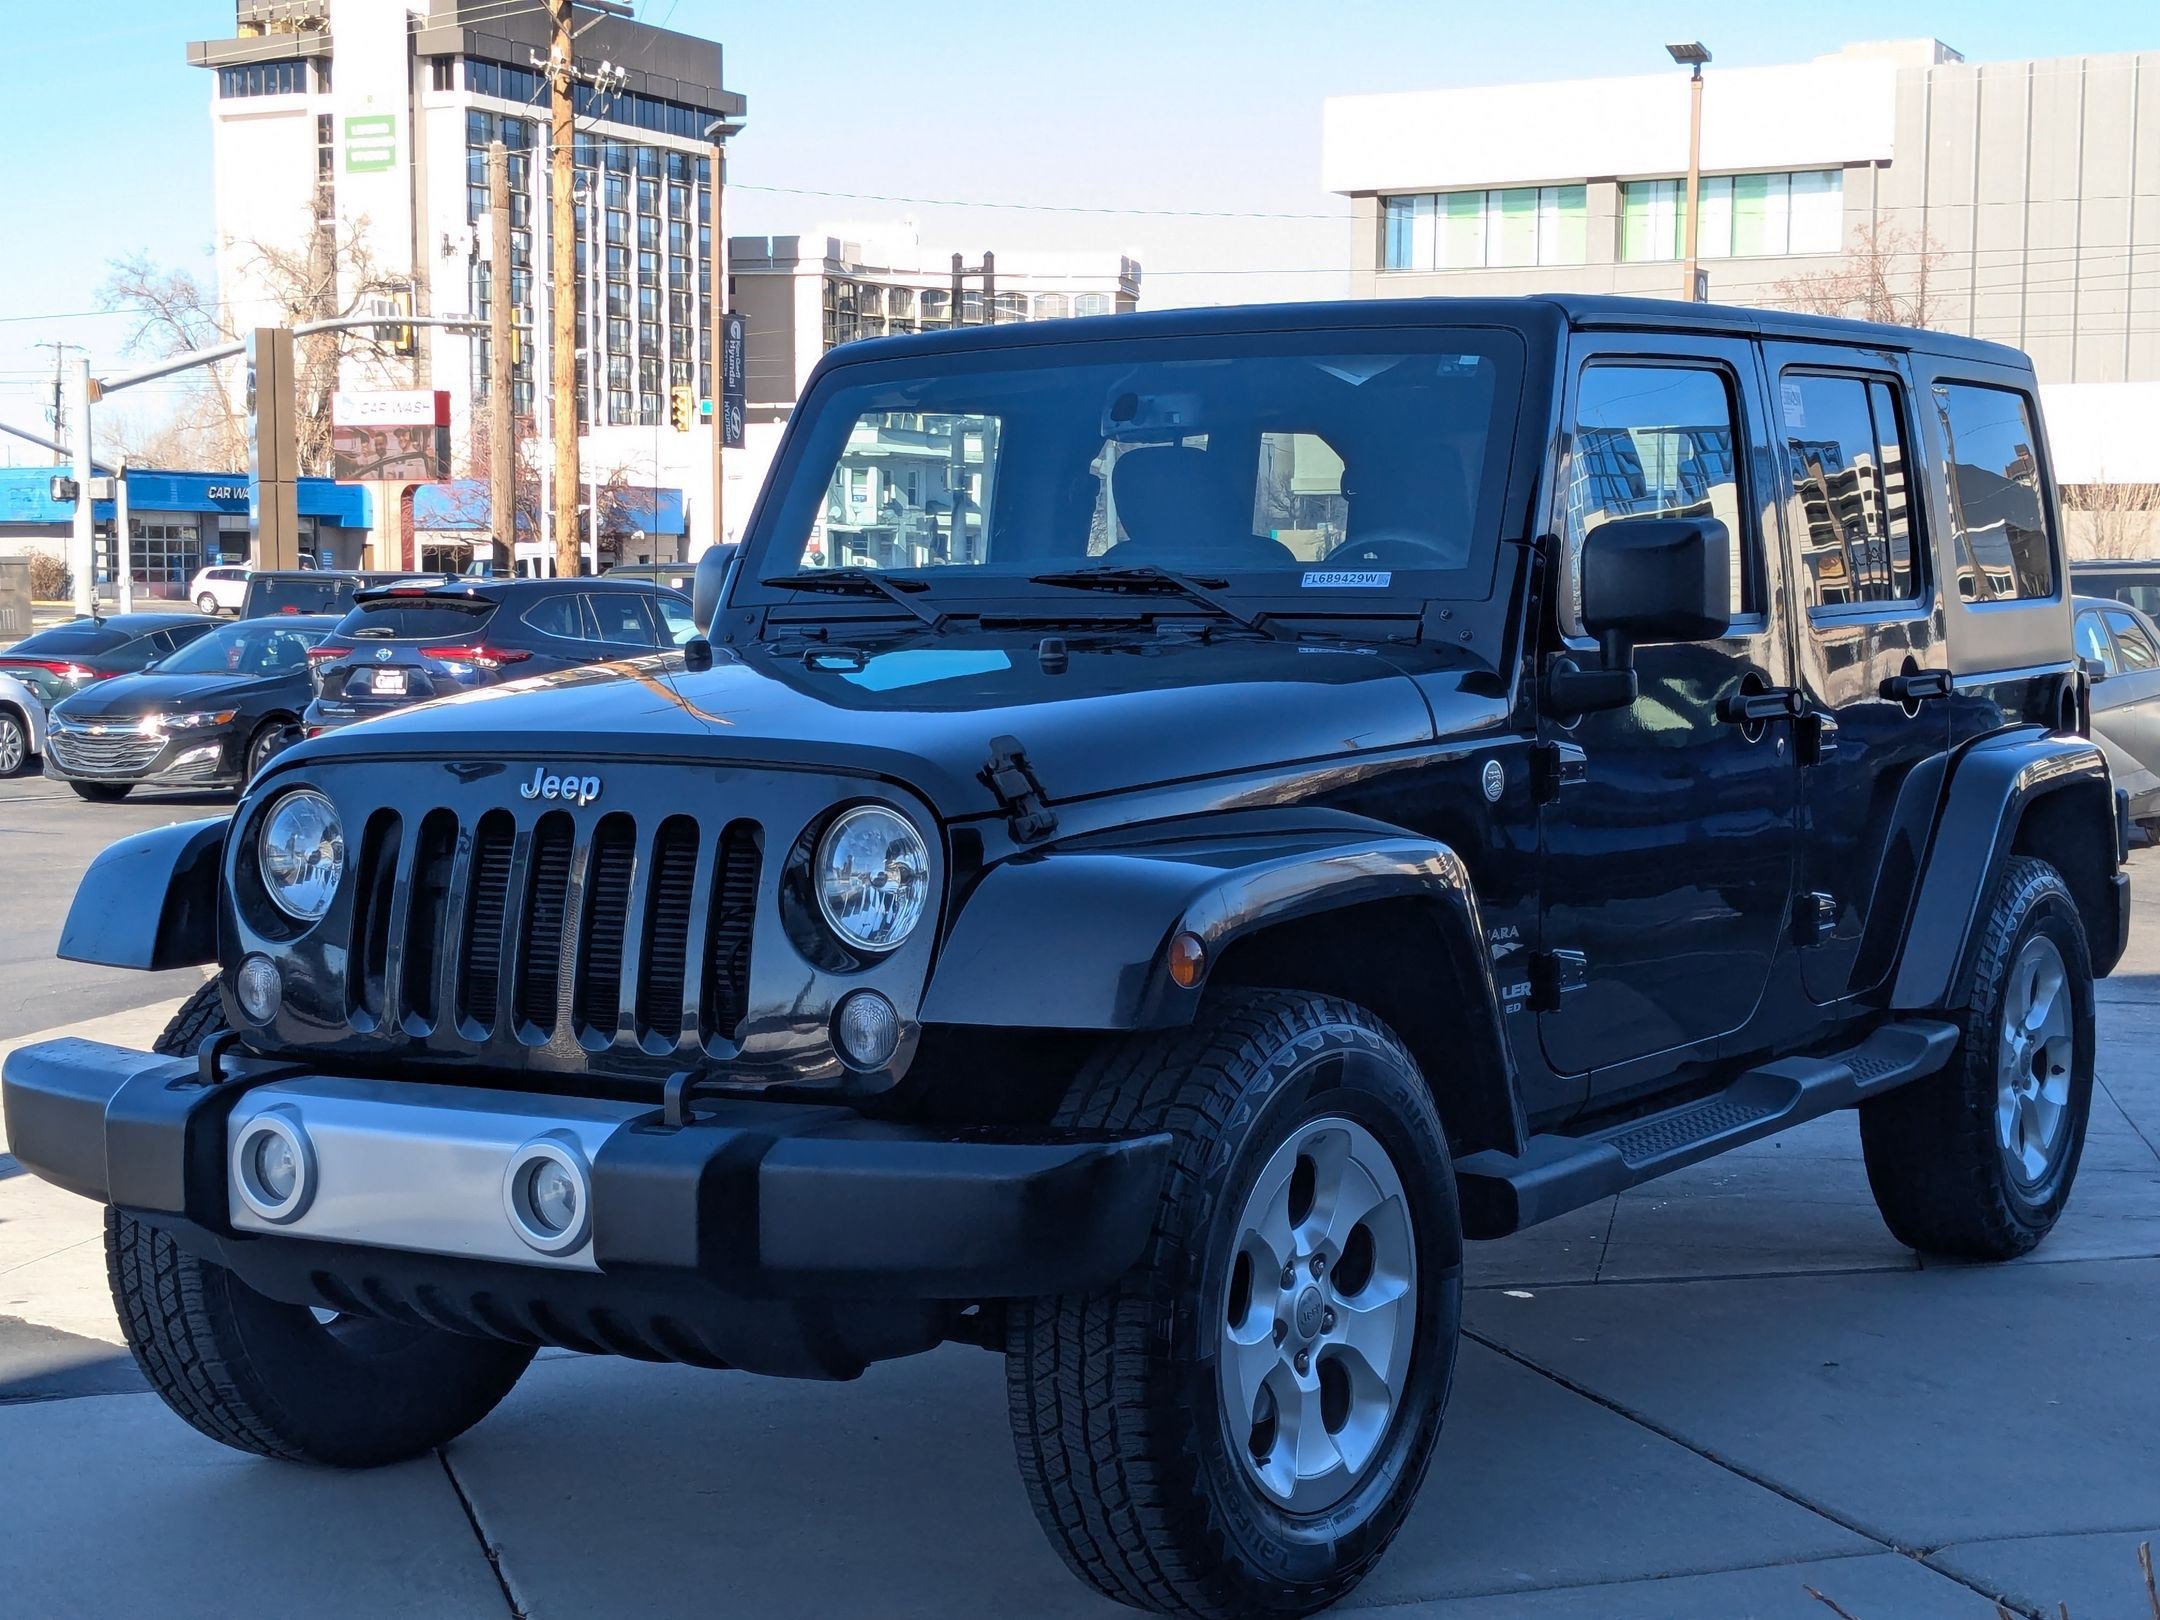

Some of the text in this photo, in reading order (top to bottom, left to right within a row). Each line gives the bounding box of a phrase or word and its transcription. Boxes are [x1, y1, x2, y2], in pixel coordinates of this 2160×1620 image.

[208, 486, 249, 499] CAR WA
[1304, 573, 1378, 584] FL689429W
[520, 767, 601, 806] Jeep
[1486, 925, 1520, 941] ARA
[1502, 981, 1532, 1000] LER
[1505, 1002, 1522, 1014] ED
